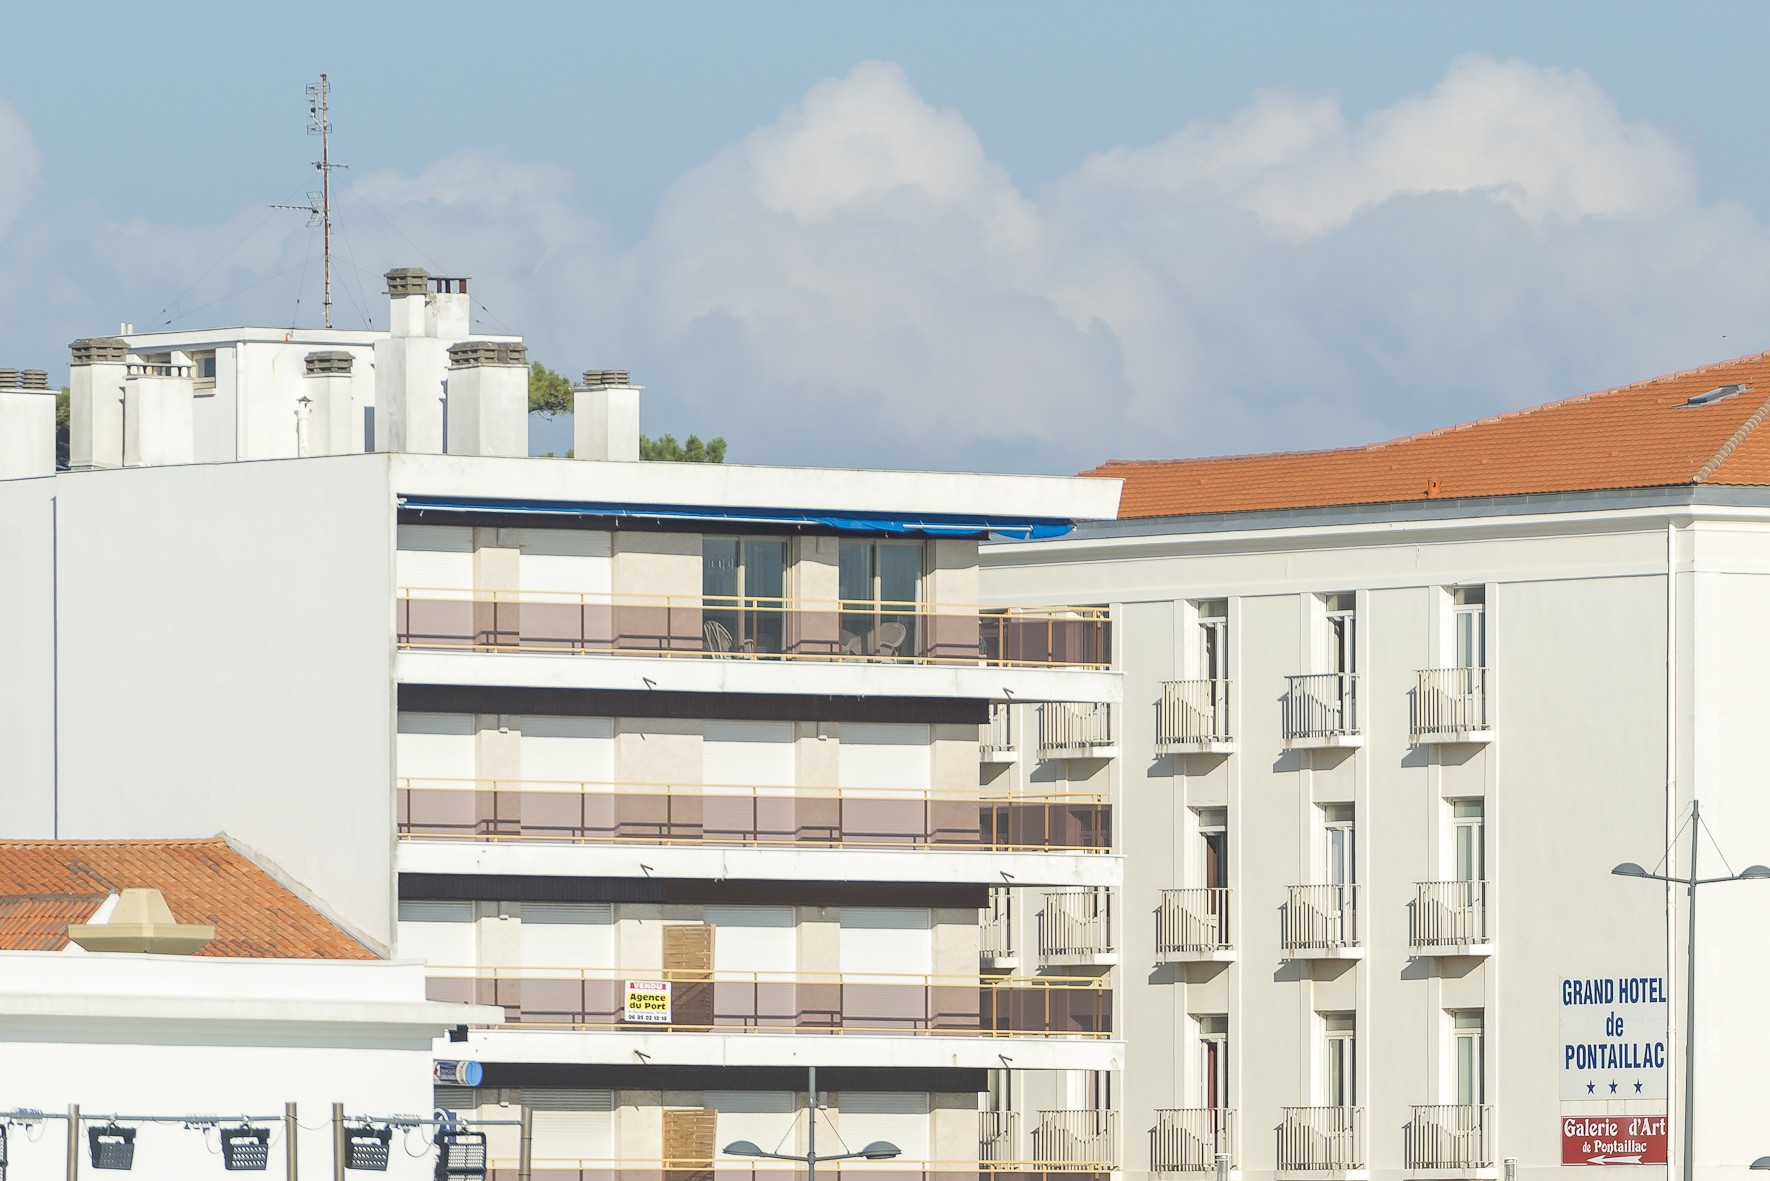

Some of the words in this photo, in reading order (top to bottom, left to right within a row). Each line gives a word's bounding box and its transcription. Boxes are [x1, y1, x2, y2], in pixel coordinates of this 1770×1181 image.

[630, 993, 666, 1002] Agence
[1562, 979, 1614, 1006] GRAND
[1619, 977, 1667, 1004] HOTEL
[1606, 1011, 1624, 1037] de
[1565, 1042, 1665, 1070] PONTAILLAC
[1563, 1117, 1618, 1137] Galerie
[1628, 1117, 1666, 1137] d'Art
[1582, 1141, 1592, 1153] de
[1593, 1139, 1647, 1155] Pontaillac
